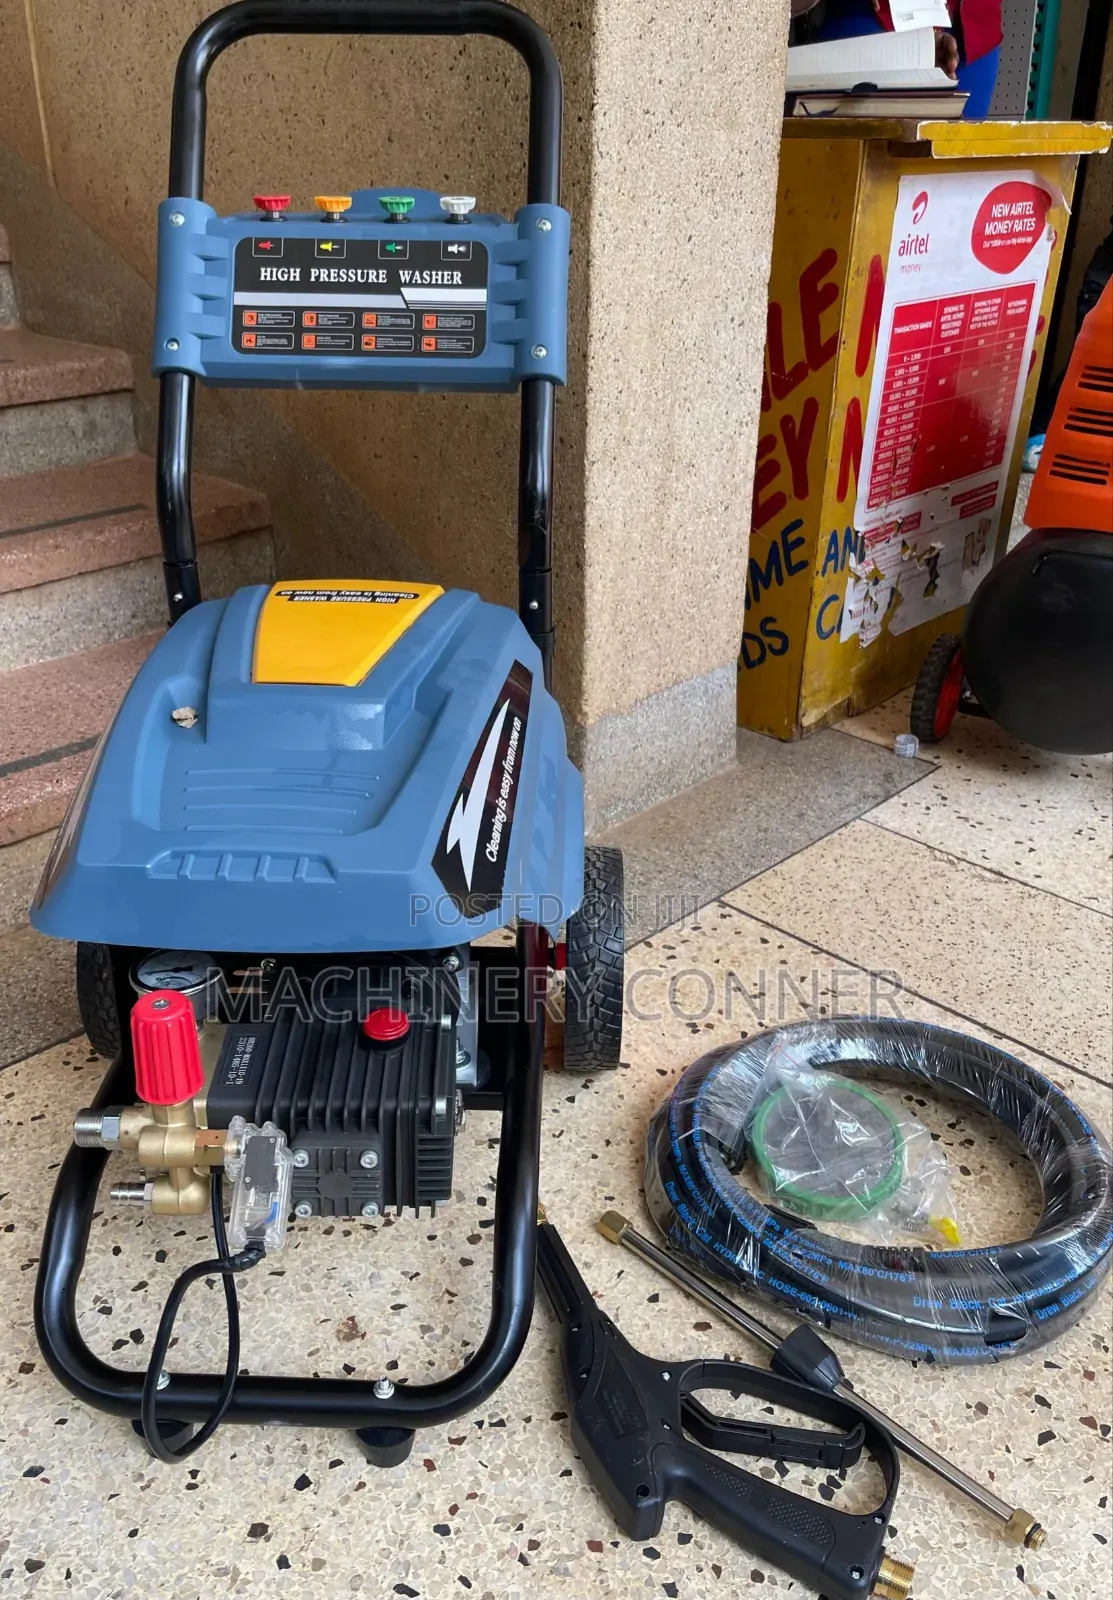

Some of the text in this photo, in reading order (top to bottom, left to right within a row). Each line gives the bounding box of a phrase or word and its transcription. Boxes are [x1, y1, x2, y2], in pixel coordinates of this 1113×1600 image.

[992, 201, 1034, 218] NEW AIRTEL
[984, 218, 1036, 236] MONEY RATES
[898, 233, 929, 257] airtel
[260, 268, 462, 284] HIGH PRESSURE WASHER
[900, 262, 922, 274] money
[762, 248, 840, 412] LE
[821, 526, 866, 578] AN
[737, 616, 789, 670] DS
[486, 716, 522, 862] Cleaning is easy from now on
[913, 1296, 943, 1309] Drew
[1035, 1303, 1060, 1320] Drew
